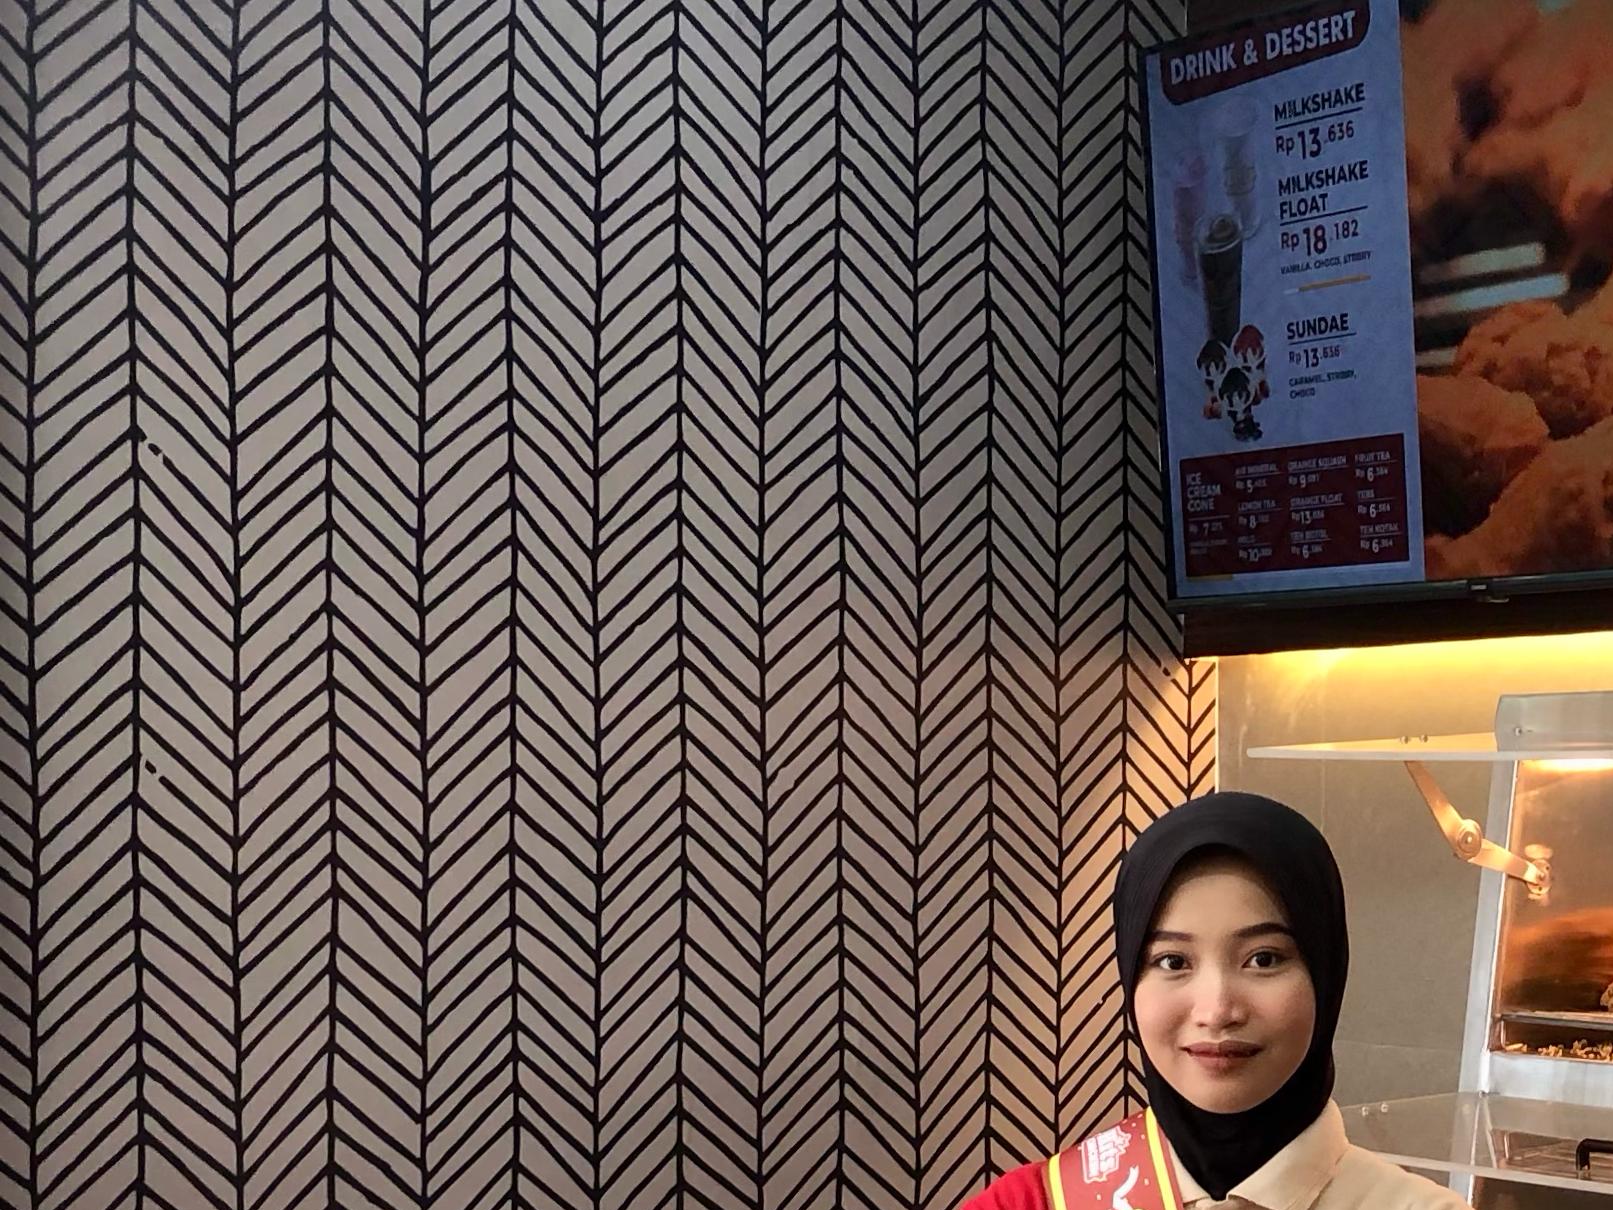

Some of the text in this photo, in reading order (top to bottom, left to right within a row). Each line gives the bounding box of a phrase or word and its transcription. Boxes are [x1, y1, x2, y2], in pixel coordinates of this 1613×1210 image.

[1170, 10, 1357, 85] DRINK & DESSERT
[1274, 83, 1365, 122] MILKSHAKE
[1278, 160, 1368, 197] MILKSHAKE
[1280, 193, 1328, 220] FLOAT
[1286, 313, 1349, 340] SUNDAE
[1185, 472, 1201, 485] ICE
[1187, 484, 1221, 498] CREAM
[1187, 498, 1214, 512] CONE
